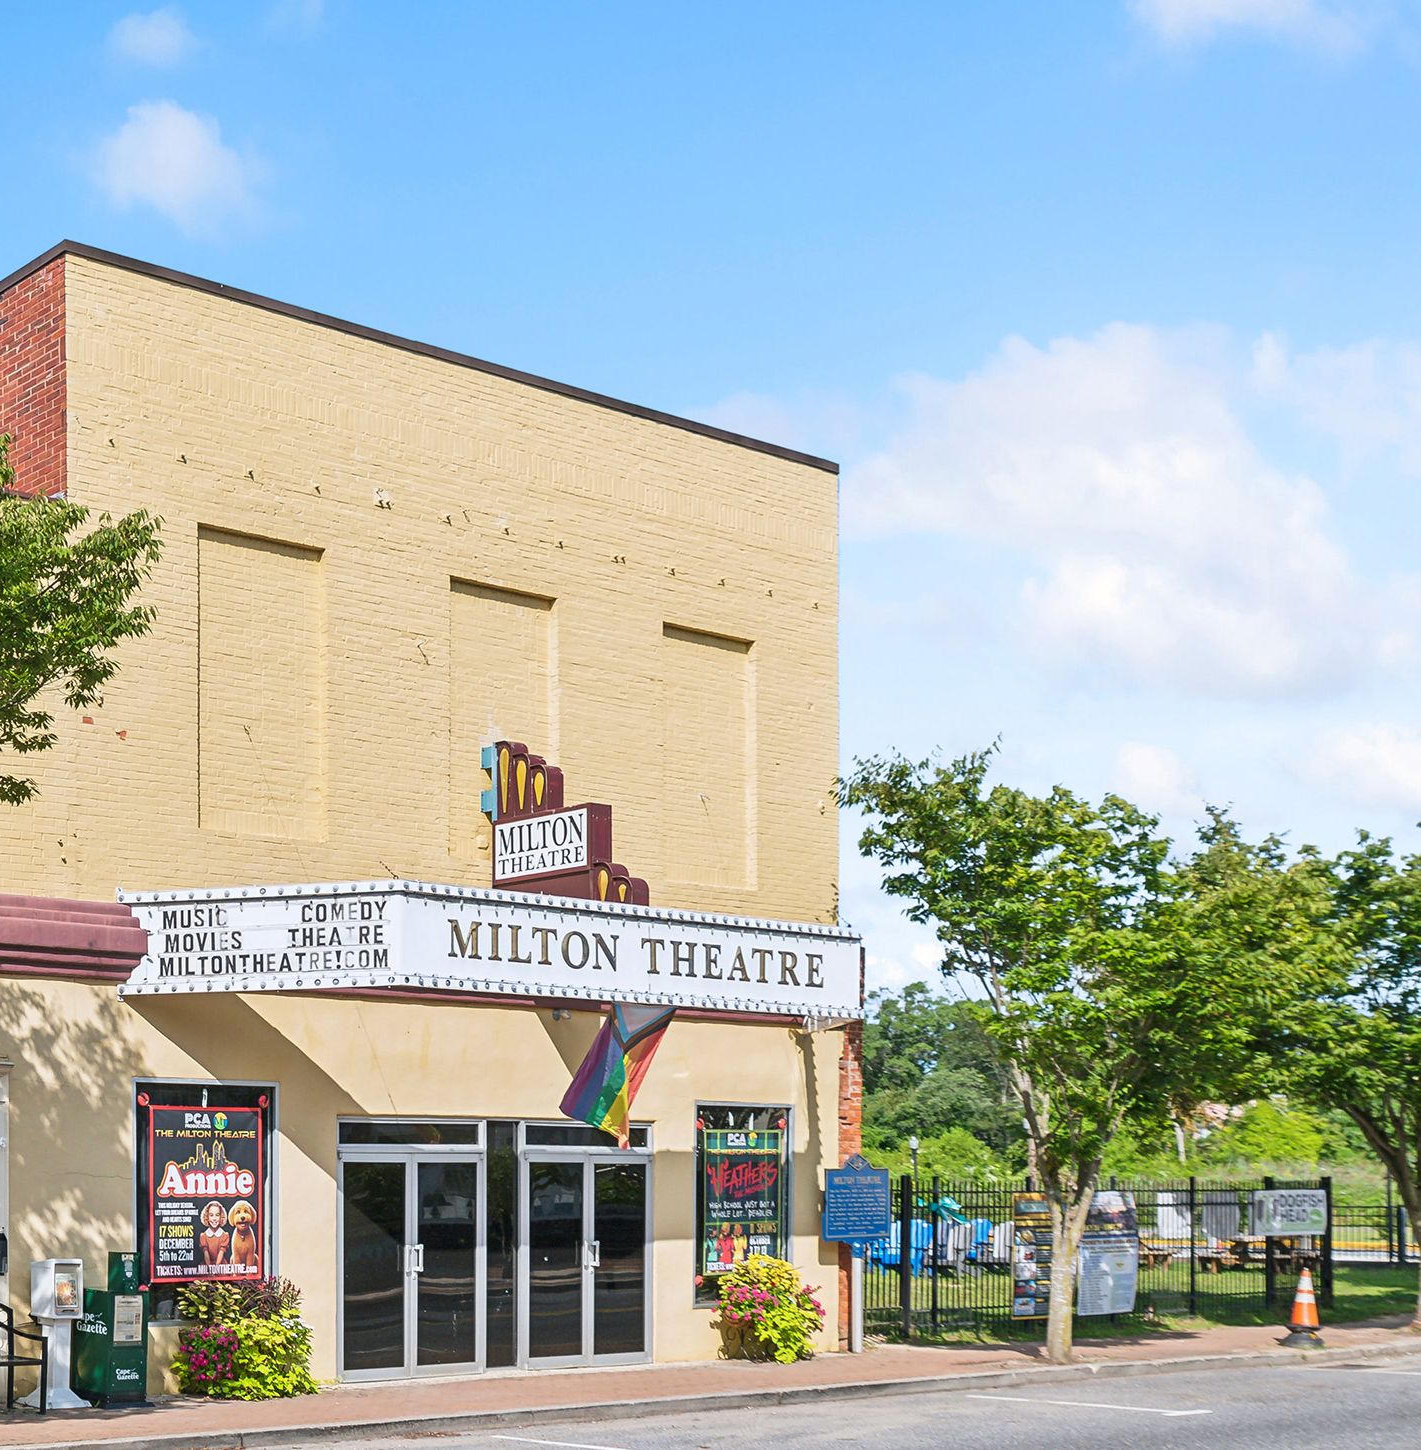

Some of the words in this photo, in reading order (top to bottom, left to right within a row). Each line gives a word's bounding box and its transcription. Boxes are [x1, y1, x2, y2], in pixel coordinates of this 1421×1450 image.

[498, 812, 584, 857] MILTON
[498, 846, 585, 876] THEATRE
[162, 908, 228, 930] MUSIC
[301, 901, 388, 922] COMEDY
[165, 931, 242, 953] MOVIES
[288, 925, 384, 947] THEATRE
[447, 918, 620, 972] MILTON
[641, 937, 824, 989] THEATRE
[185, 1113, 211, 1124] PCA
[155, 1129, 174, 1138] THE
[176, 1130, 212, 1138] MILTON
[214, 1130, 256, 1138] THEATRE
[727, 1133, 746, 1143] PCA
[159, 1163, 253, 1196] Annie
[707, 1158, 778, 1197] HEATHERS
[723, 1201, 742, 1209] SCHOOL
[744, 1200, 758, 1210] JUST
[759, 1201, 770, 1209] GOT
[711, 1210, 731, 1218] WHOLE
[159, 1226, 167, 1238] 17
[167, 1225, 194, 1237] SHOWS
[159, 1239, 194, 1250] DECEMBER
[159, 1250, 170, 1261] 5th
[171, 1252, 178, 1261] to
[179, 1250, 193, 1261] 22nd
[156, 1266, 183, 1276] TICKETS:
[183, 1264, 257, 1275] www.MILTONTHEATRE.com
[83, 1313, 95, 1324] pe
[76, 1320, 108, 1335] Gazette
[115, 1368, 131, 1376] Cape
